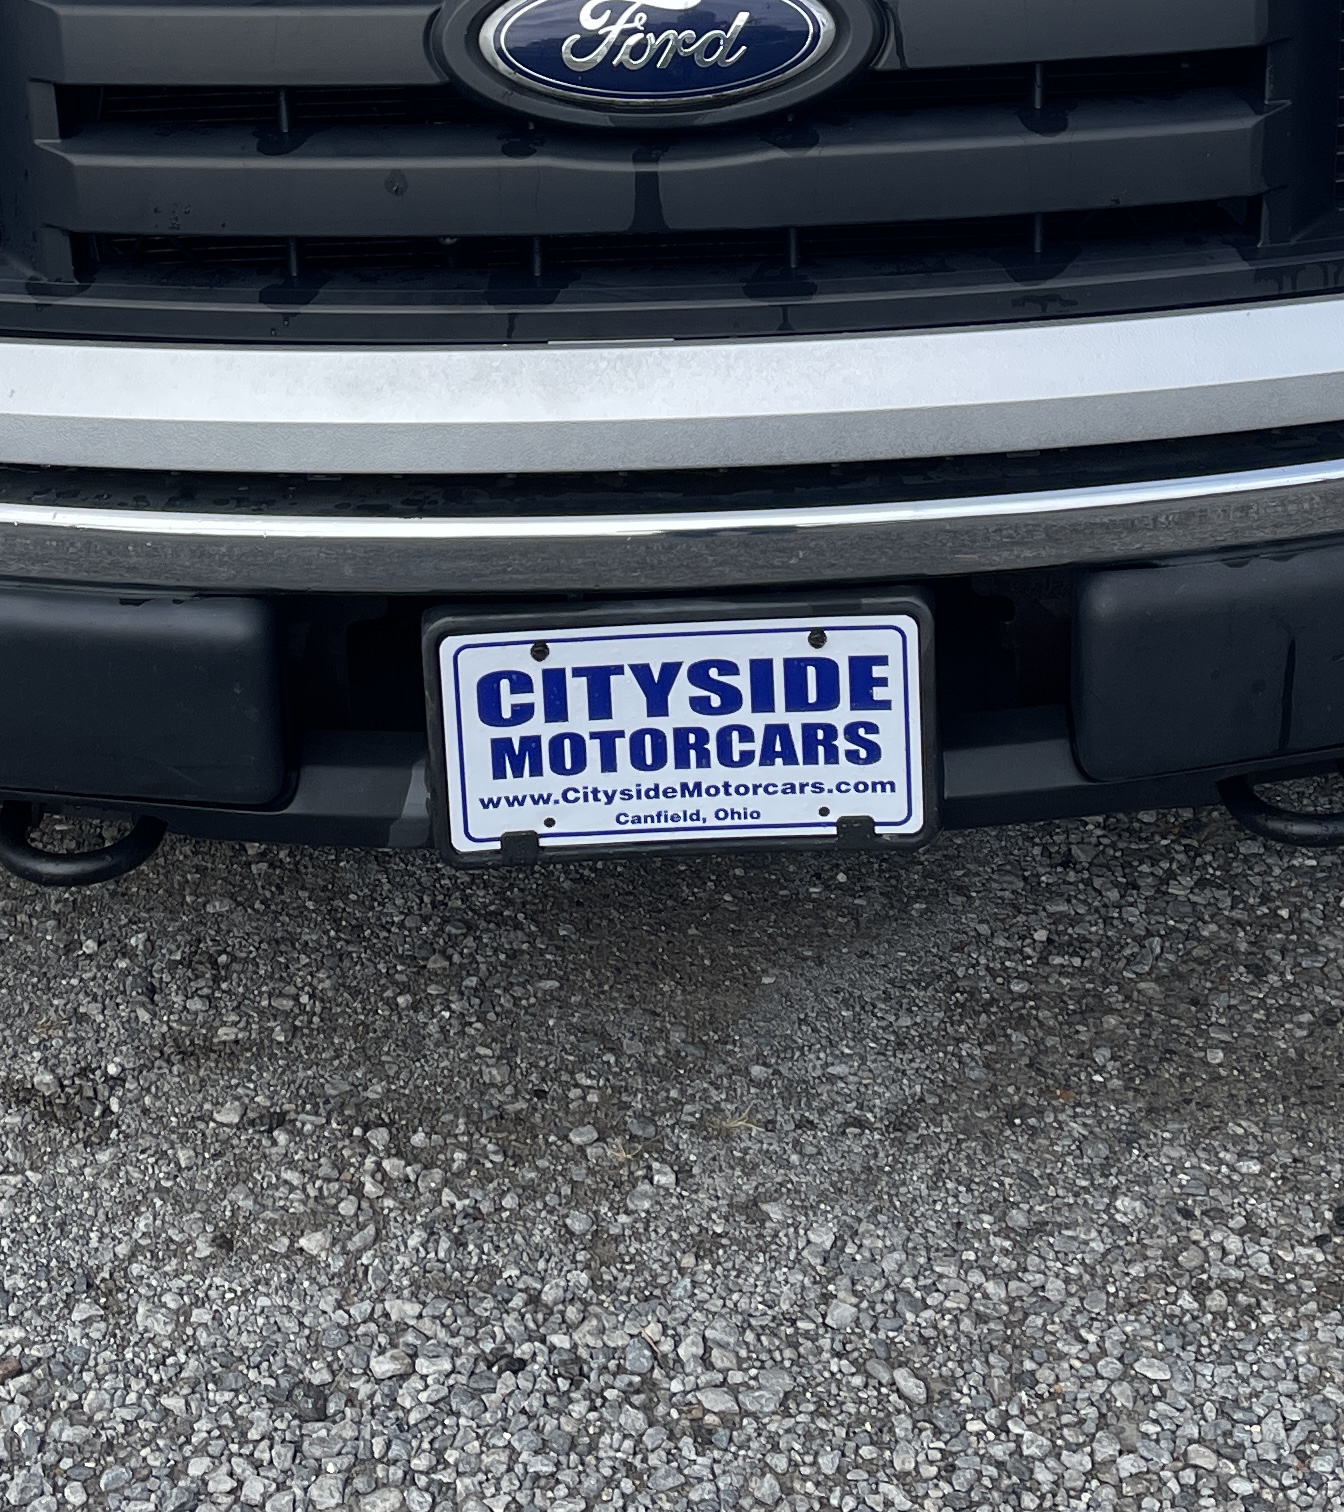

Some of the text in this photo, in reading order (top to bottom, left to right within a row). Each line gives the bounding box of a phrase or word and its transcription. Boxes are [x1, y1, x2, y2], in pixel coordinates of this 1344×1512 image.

[475, 654, 893, 729] CITYSIDE
[490, 721, 883, 781] MOTORCARS
[479, 777, 896, 810] www.CitysideMotorcars.com
[614, 806, 761, 827] Canfield, Ohio
